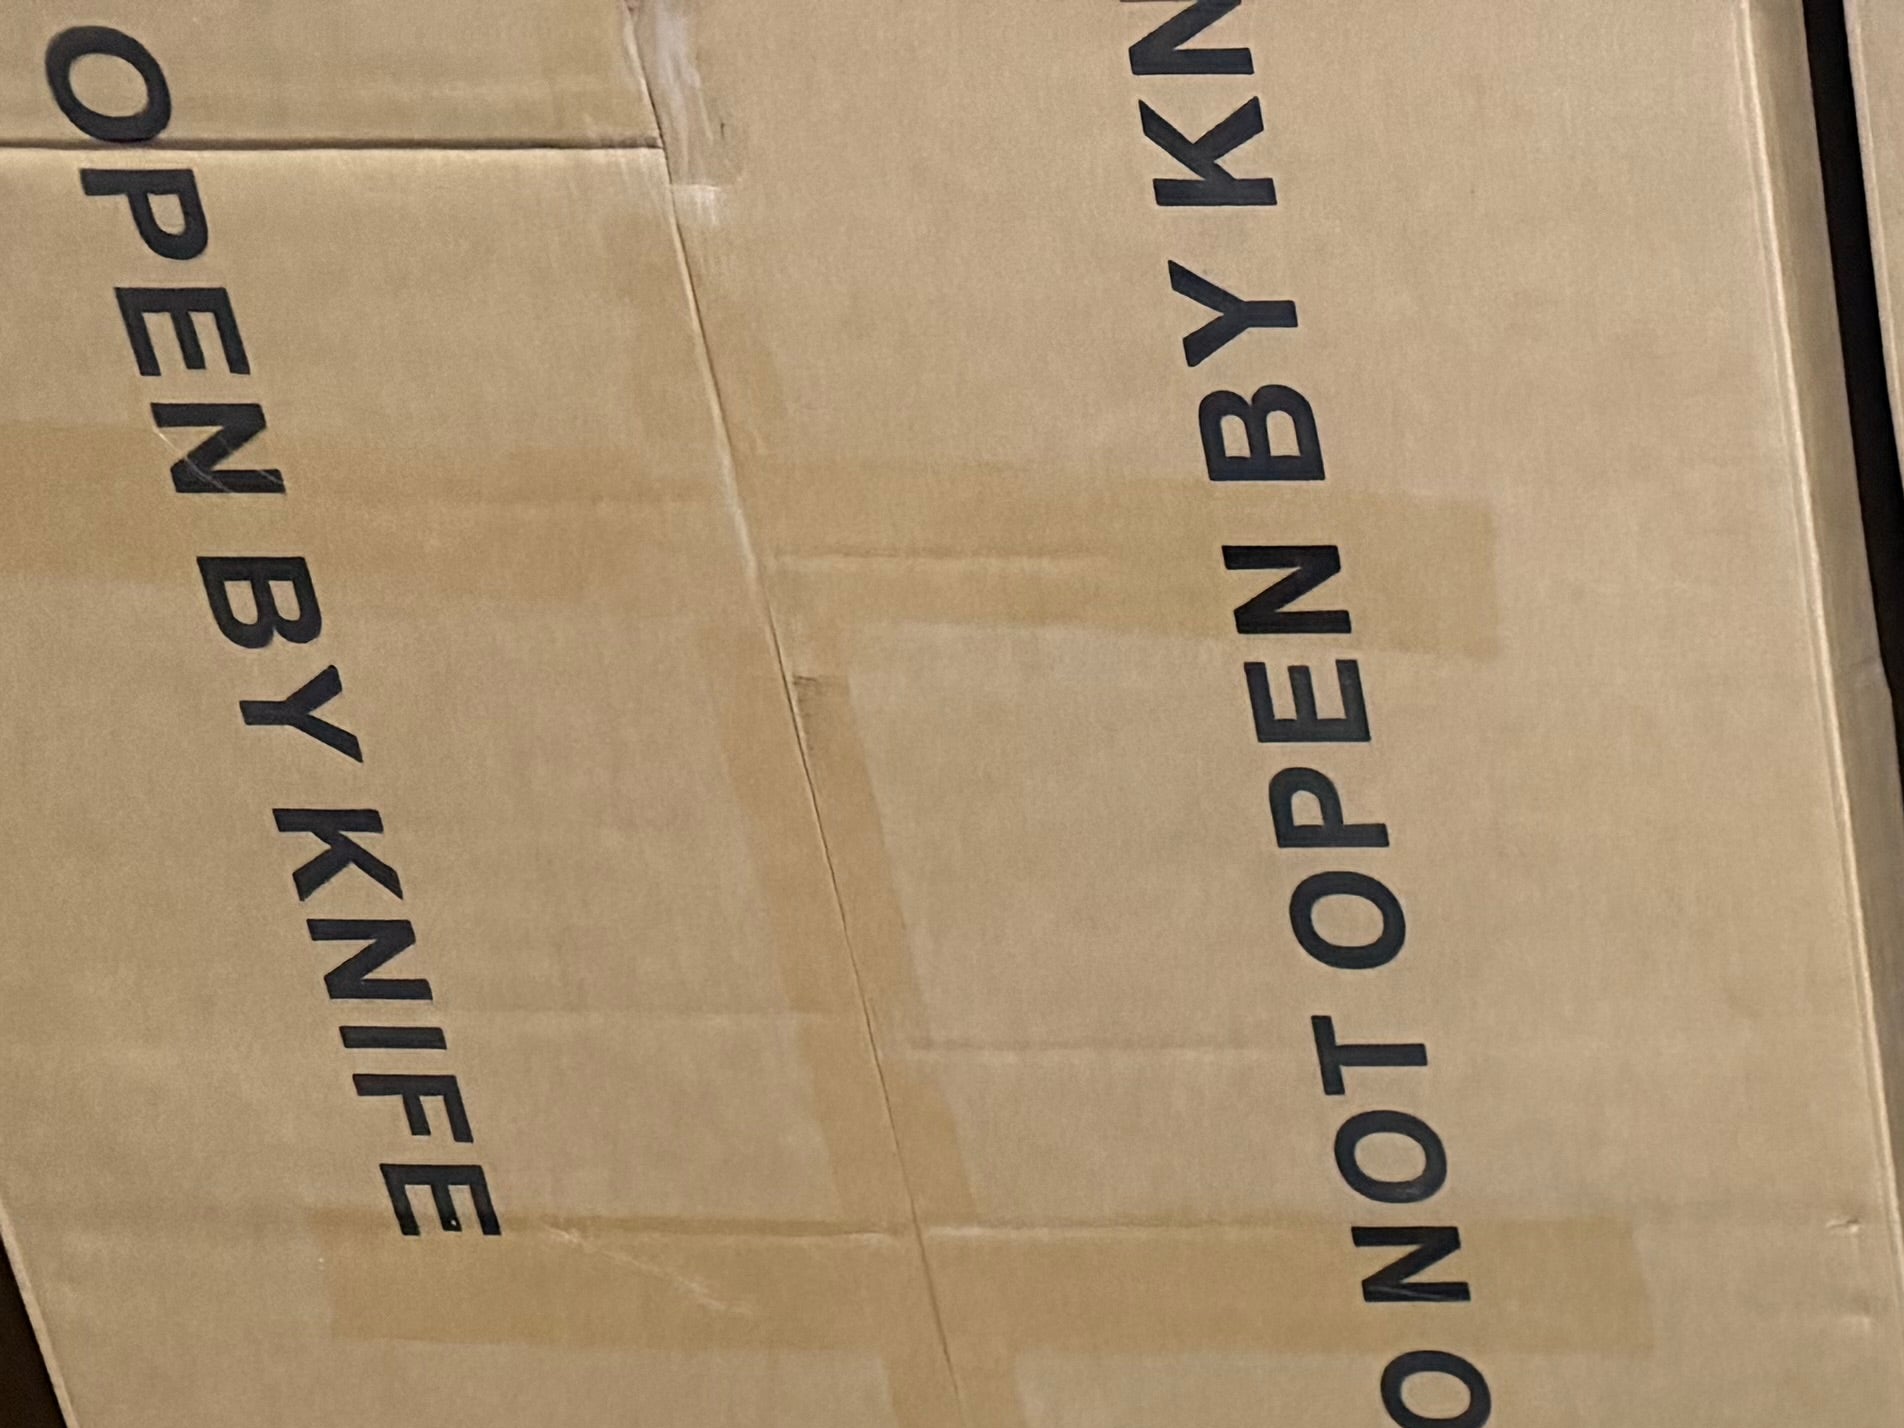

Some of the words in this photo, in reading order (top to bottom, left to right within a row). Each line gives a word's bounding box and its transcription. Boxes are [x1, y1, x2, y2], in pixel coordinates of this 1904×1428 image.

[43, 24, 288, 496] OPEN
[1166, 258, 1327, 483] BY
[195, 554, 365, 765] BY
[1220, 543, 1407, 971] OPEN
[270, 806, 503, 1238] KNIFE
[1309, 1013, 1474, 1304] NOT
